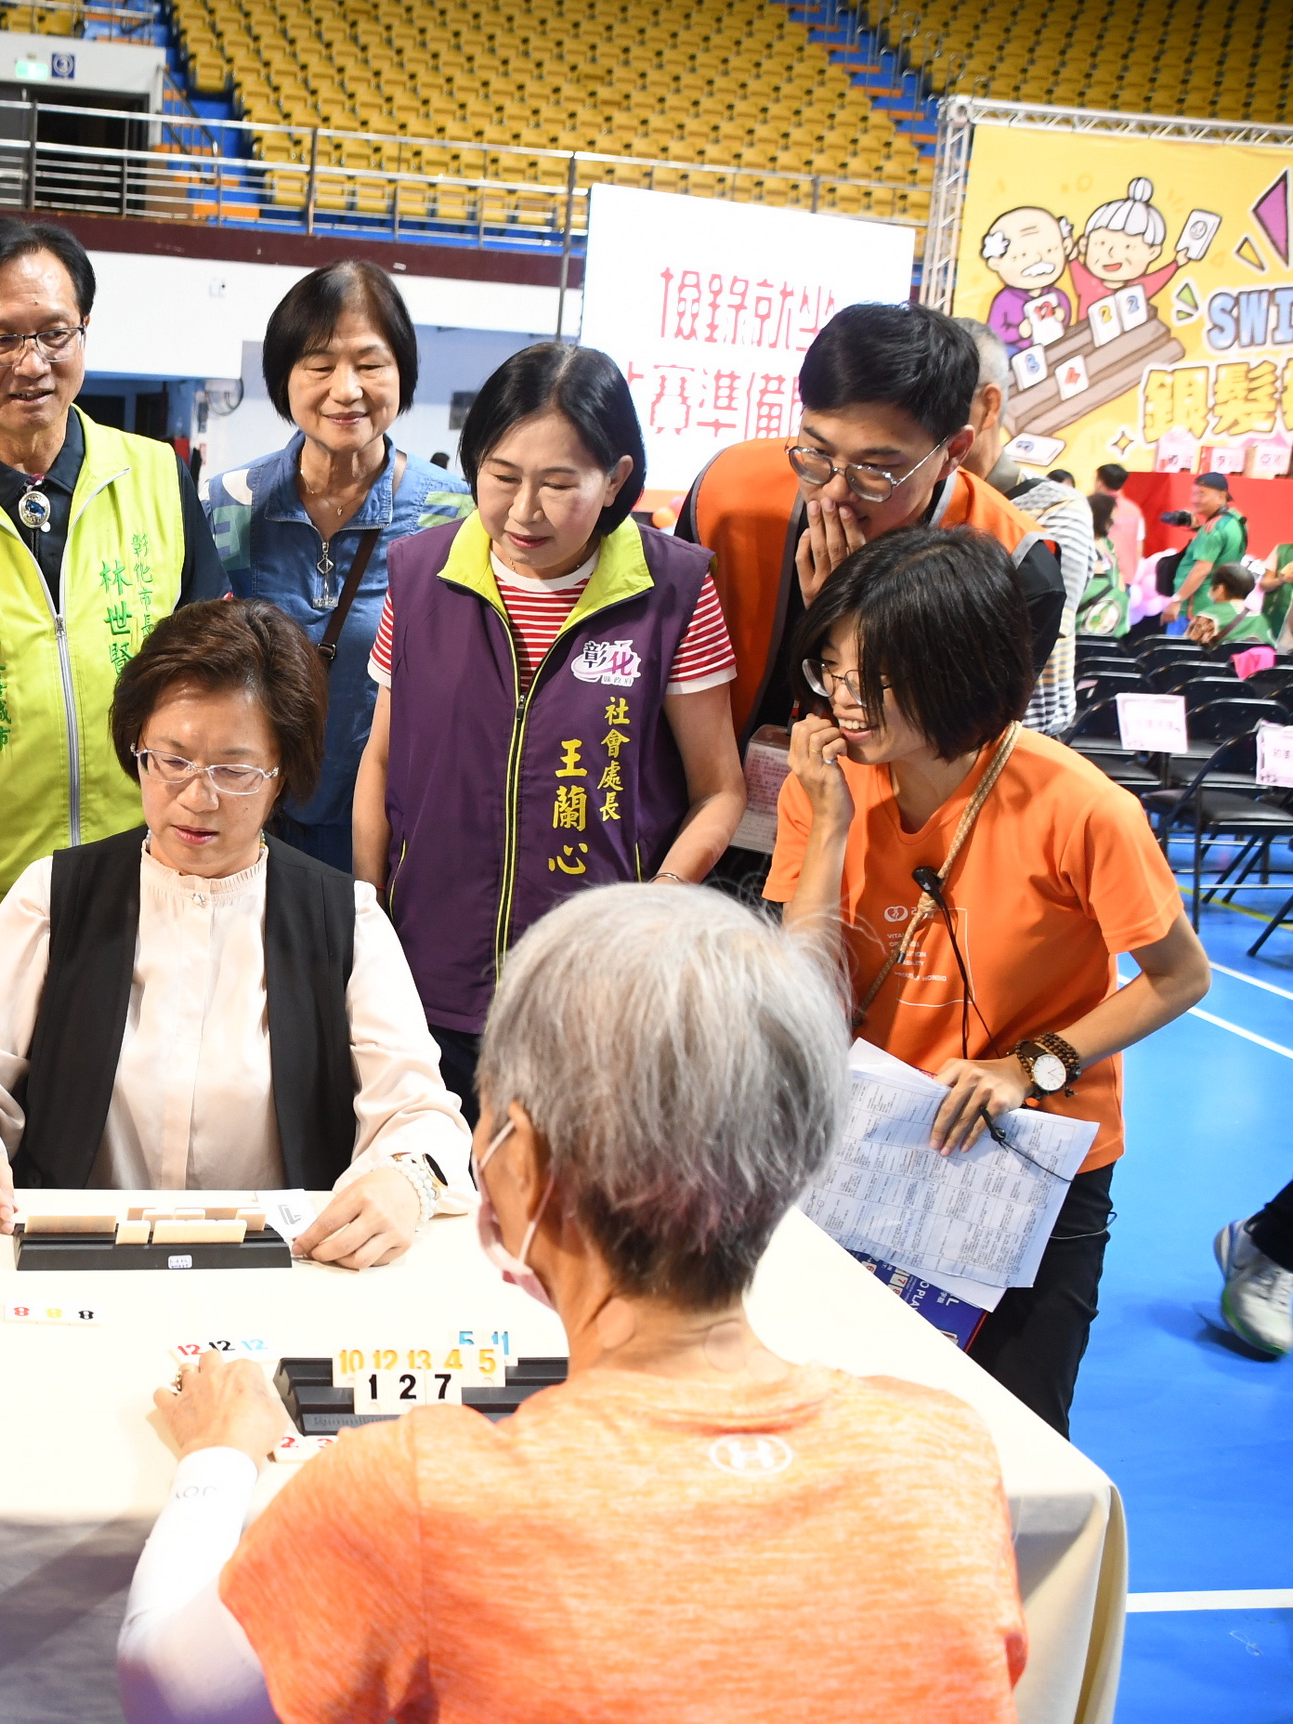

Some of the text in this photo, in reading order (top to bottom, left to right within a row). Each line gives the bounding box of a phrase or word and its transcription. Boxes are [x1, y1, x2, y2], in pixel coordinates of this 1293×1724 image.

[627, 360, 802, 440] 賽準備
[1143, 358, 1293, 443] 銀髮
[99, 560, 136, 676] 林世賢
[131, 533, 155, 638] 彰化市長
[583, 641, 635, 676] 彰化
[597, 696, 630, 822] 社會處長
[548, 739, 589, 875] 王蘭心
[13, 1306, 30, 1317] 8
[78, 1310, 94, 1320] 8
[177, 1339, 268, 1356] 12 12 12
[339, 1349, 497, 1375] 10 12 13 4 5
[368, 1374, 452, 1400] 1 2 7
